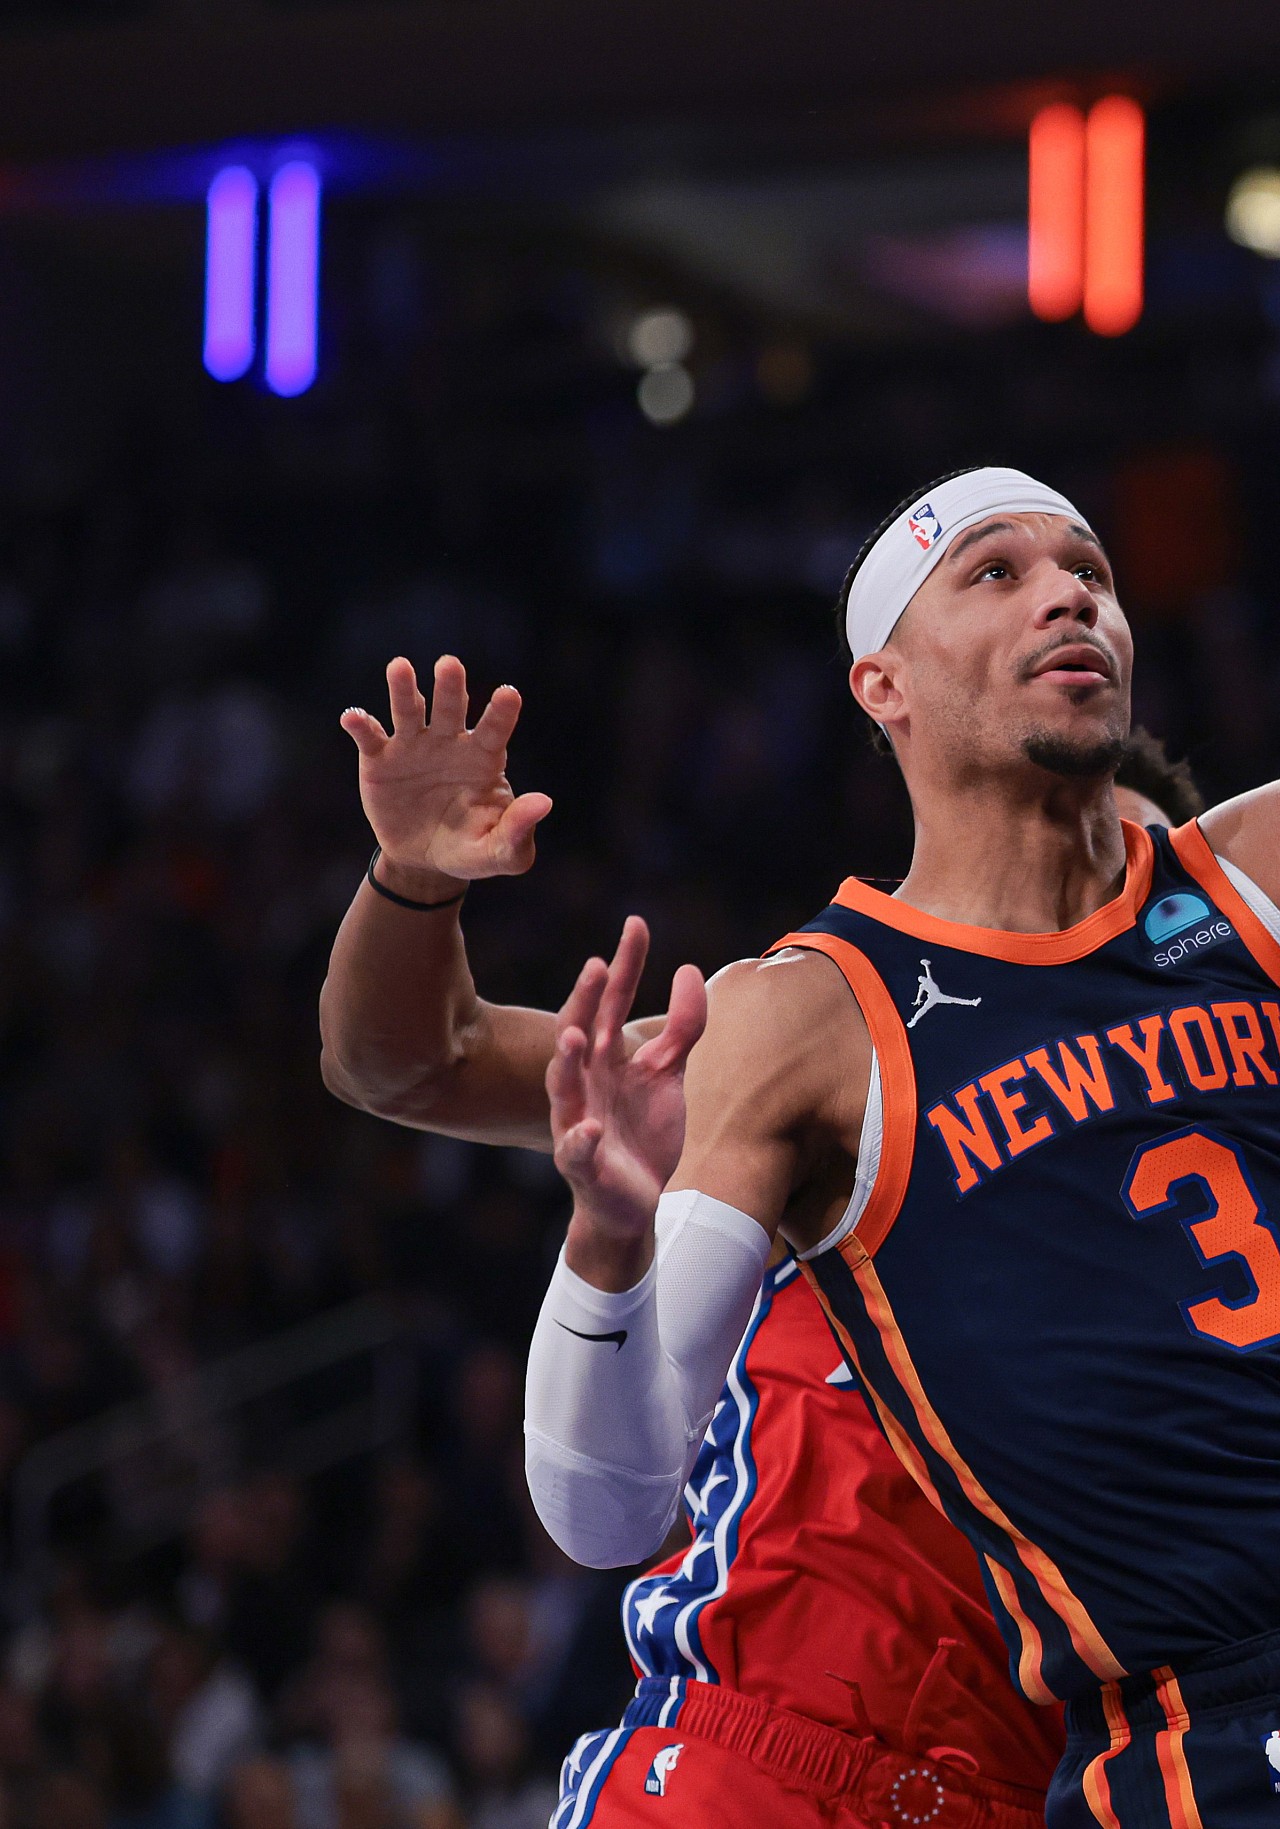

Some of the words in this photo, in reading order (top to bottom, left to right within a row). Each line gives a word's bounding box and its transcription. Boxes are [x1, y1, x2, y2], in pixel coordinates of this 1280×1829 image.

[915, 505, 930, 519] NBA
[1154, 922, 1231, 966] sphere
[924, 1030, 1116, 1197] NEW
[645, 1779, 660, 1793] NBA
